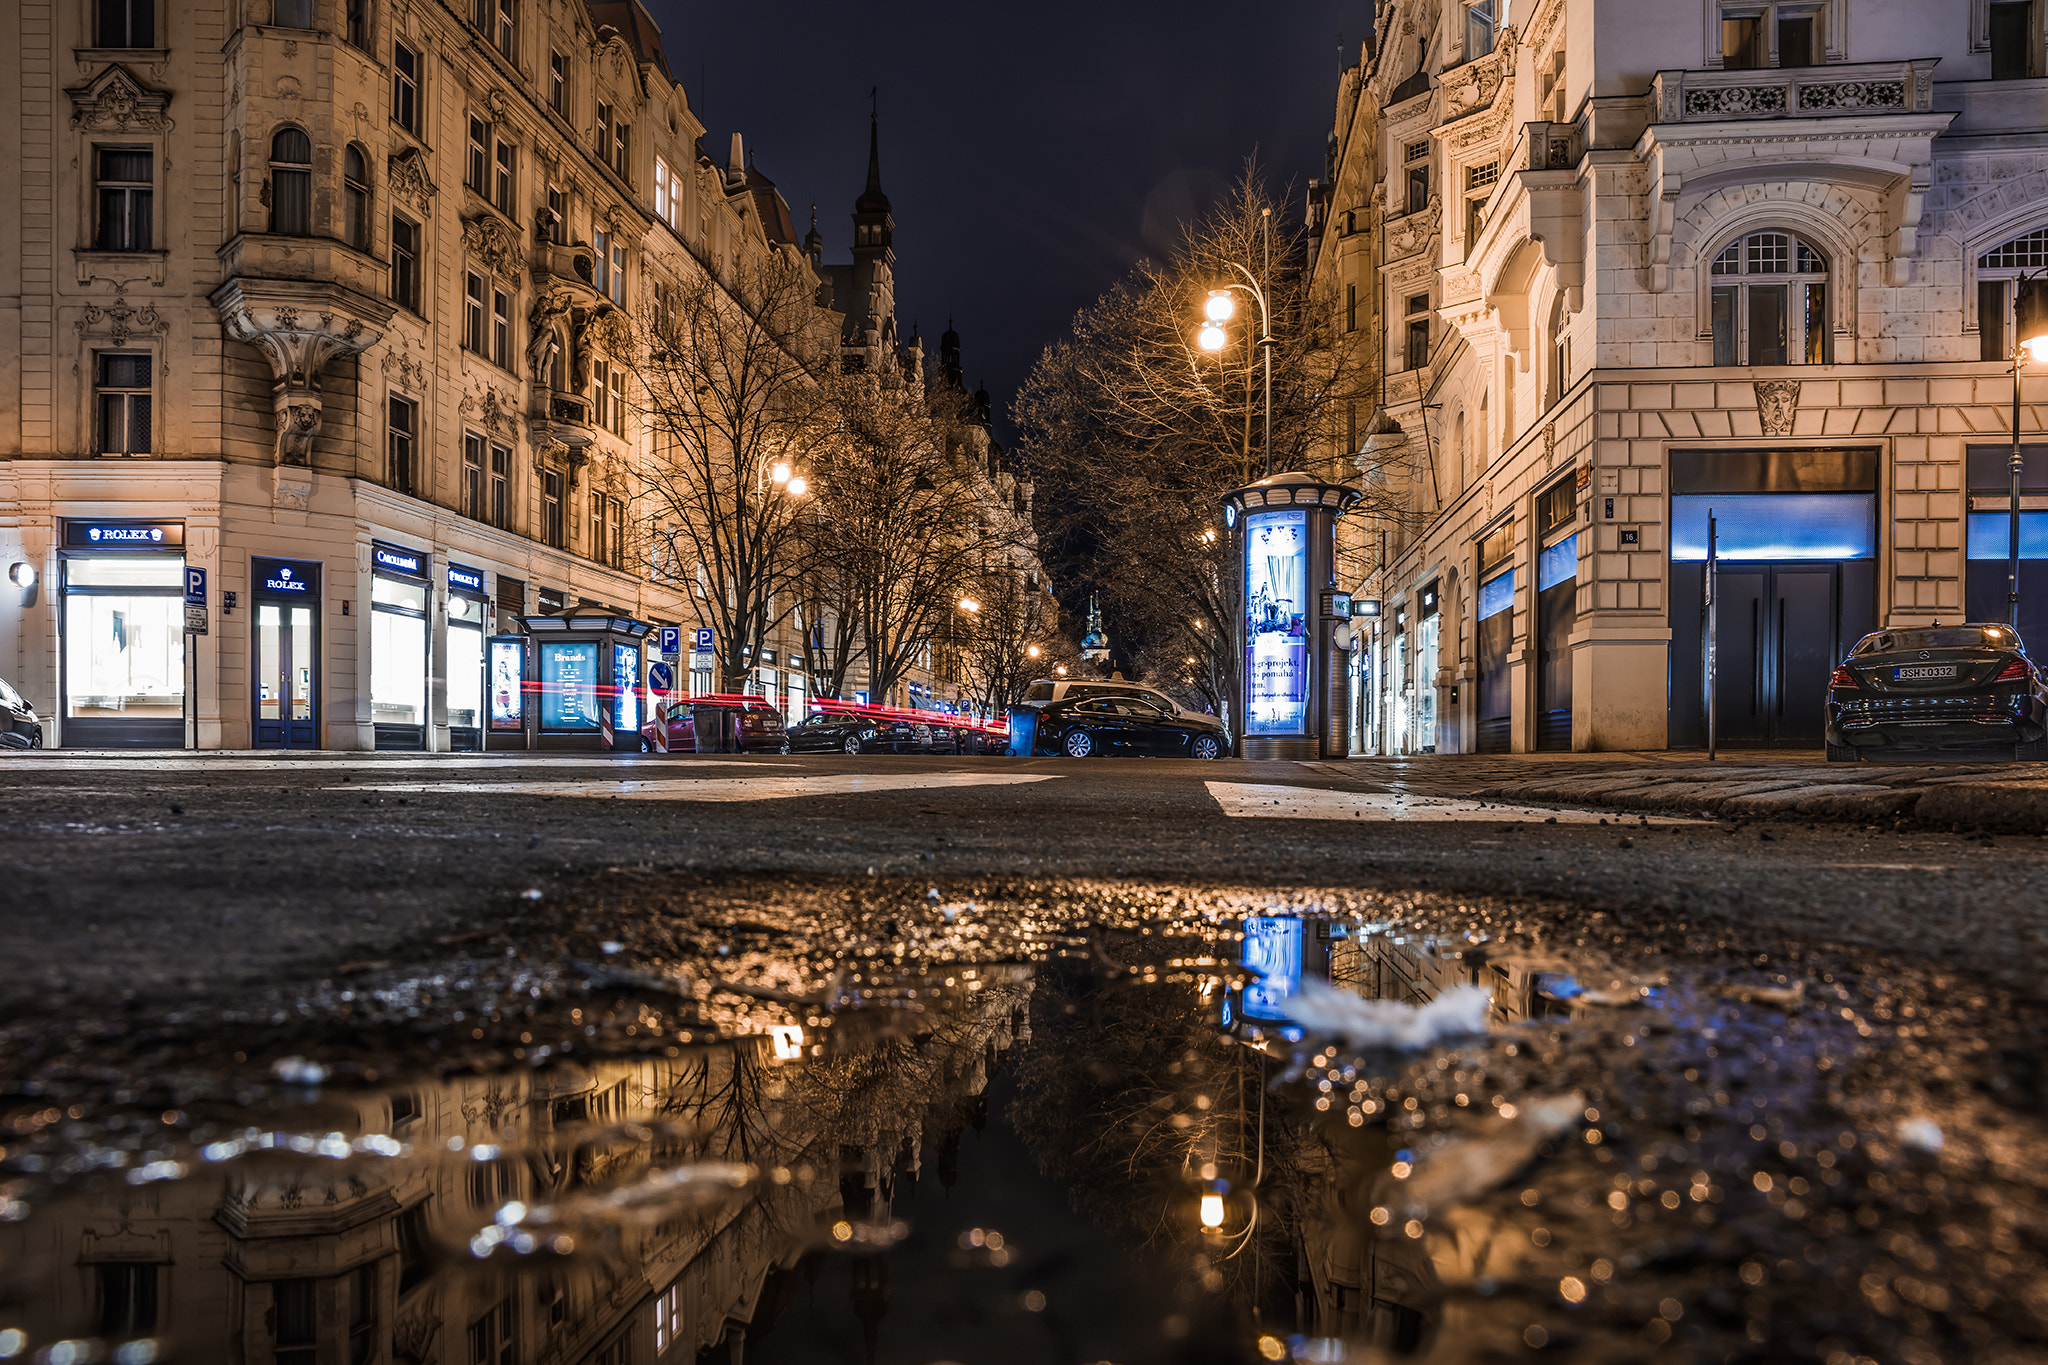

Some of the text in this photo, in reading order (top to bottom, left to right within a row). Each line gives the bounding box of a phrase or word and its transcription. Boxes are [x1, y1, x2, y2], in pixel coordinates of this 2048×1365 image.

[102, 529, 150, 540] ROLEX
[1625, 533, 1634, 541] 16
[189, 571, 202, 593] P
[266, 579, 306, 591] ROLEX
[664, 630, 676, 646] P
[700, 631, 710, 646] P
[554, 653, 586, 662] Brands
[1902, 669, 1920, 678] 3SH
[1927, 667, 1952, 677] 0332
